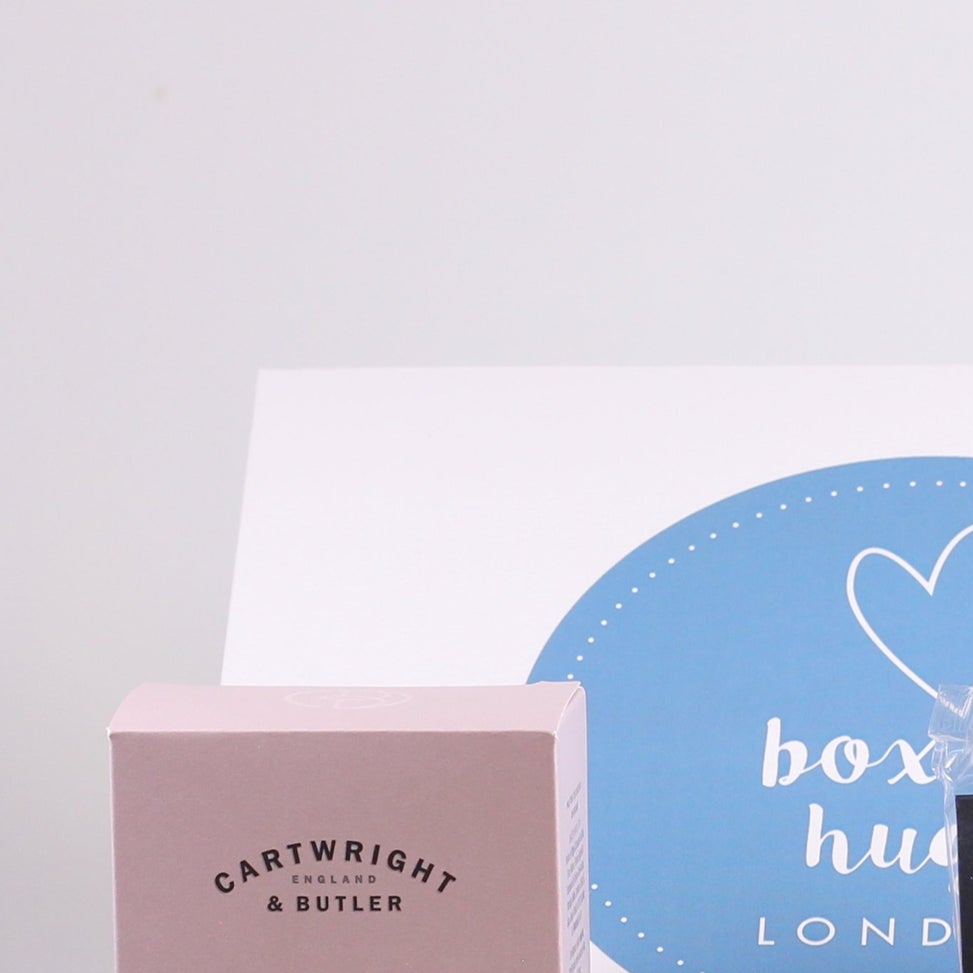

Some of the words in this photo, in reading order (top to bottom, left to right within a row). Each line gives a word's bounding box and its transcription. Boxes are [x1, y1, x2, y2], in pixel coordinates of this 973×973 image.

[762, 717, 938, 787] box
[214, 839, 456, 894] CARTWRIGHT
[292, 875, 377, 884] ENGLAND
[267, 896, 283, 912] &
[297, 895, 403, 912] BUTLER
[758, 916, 953, 946] LOND
